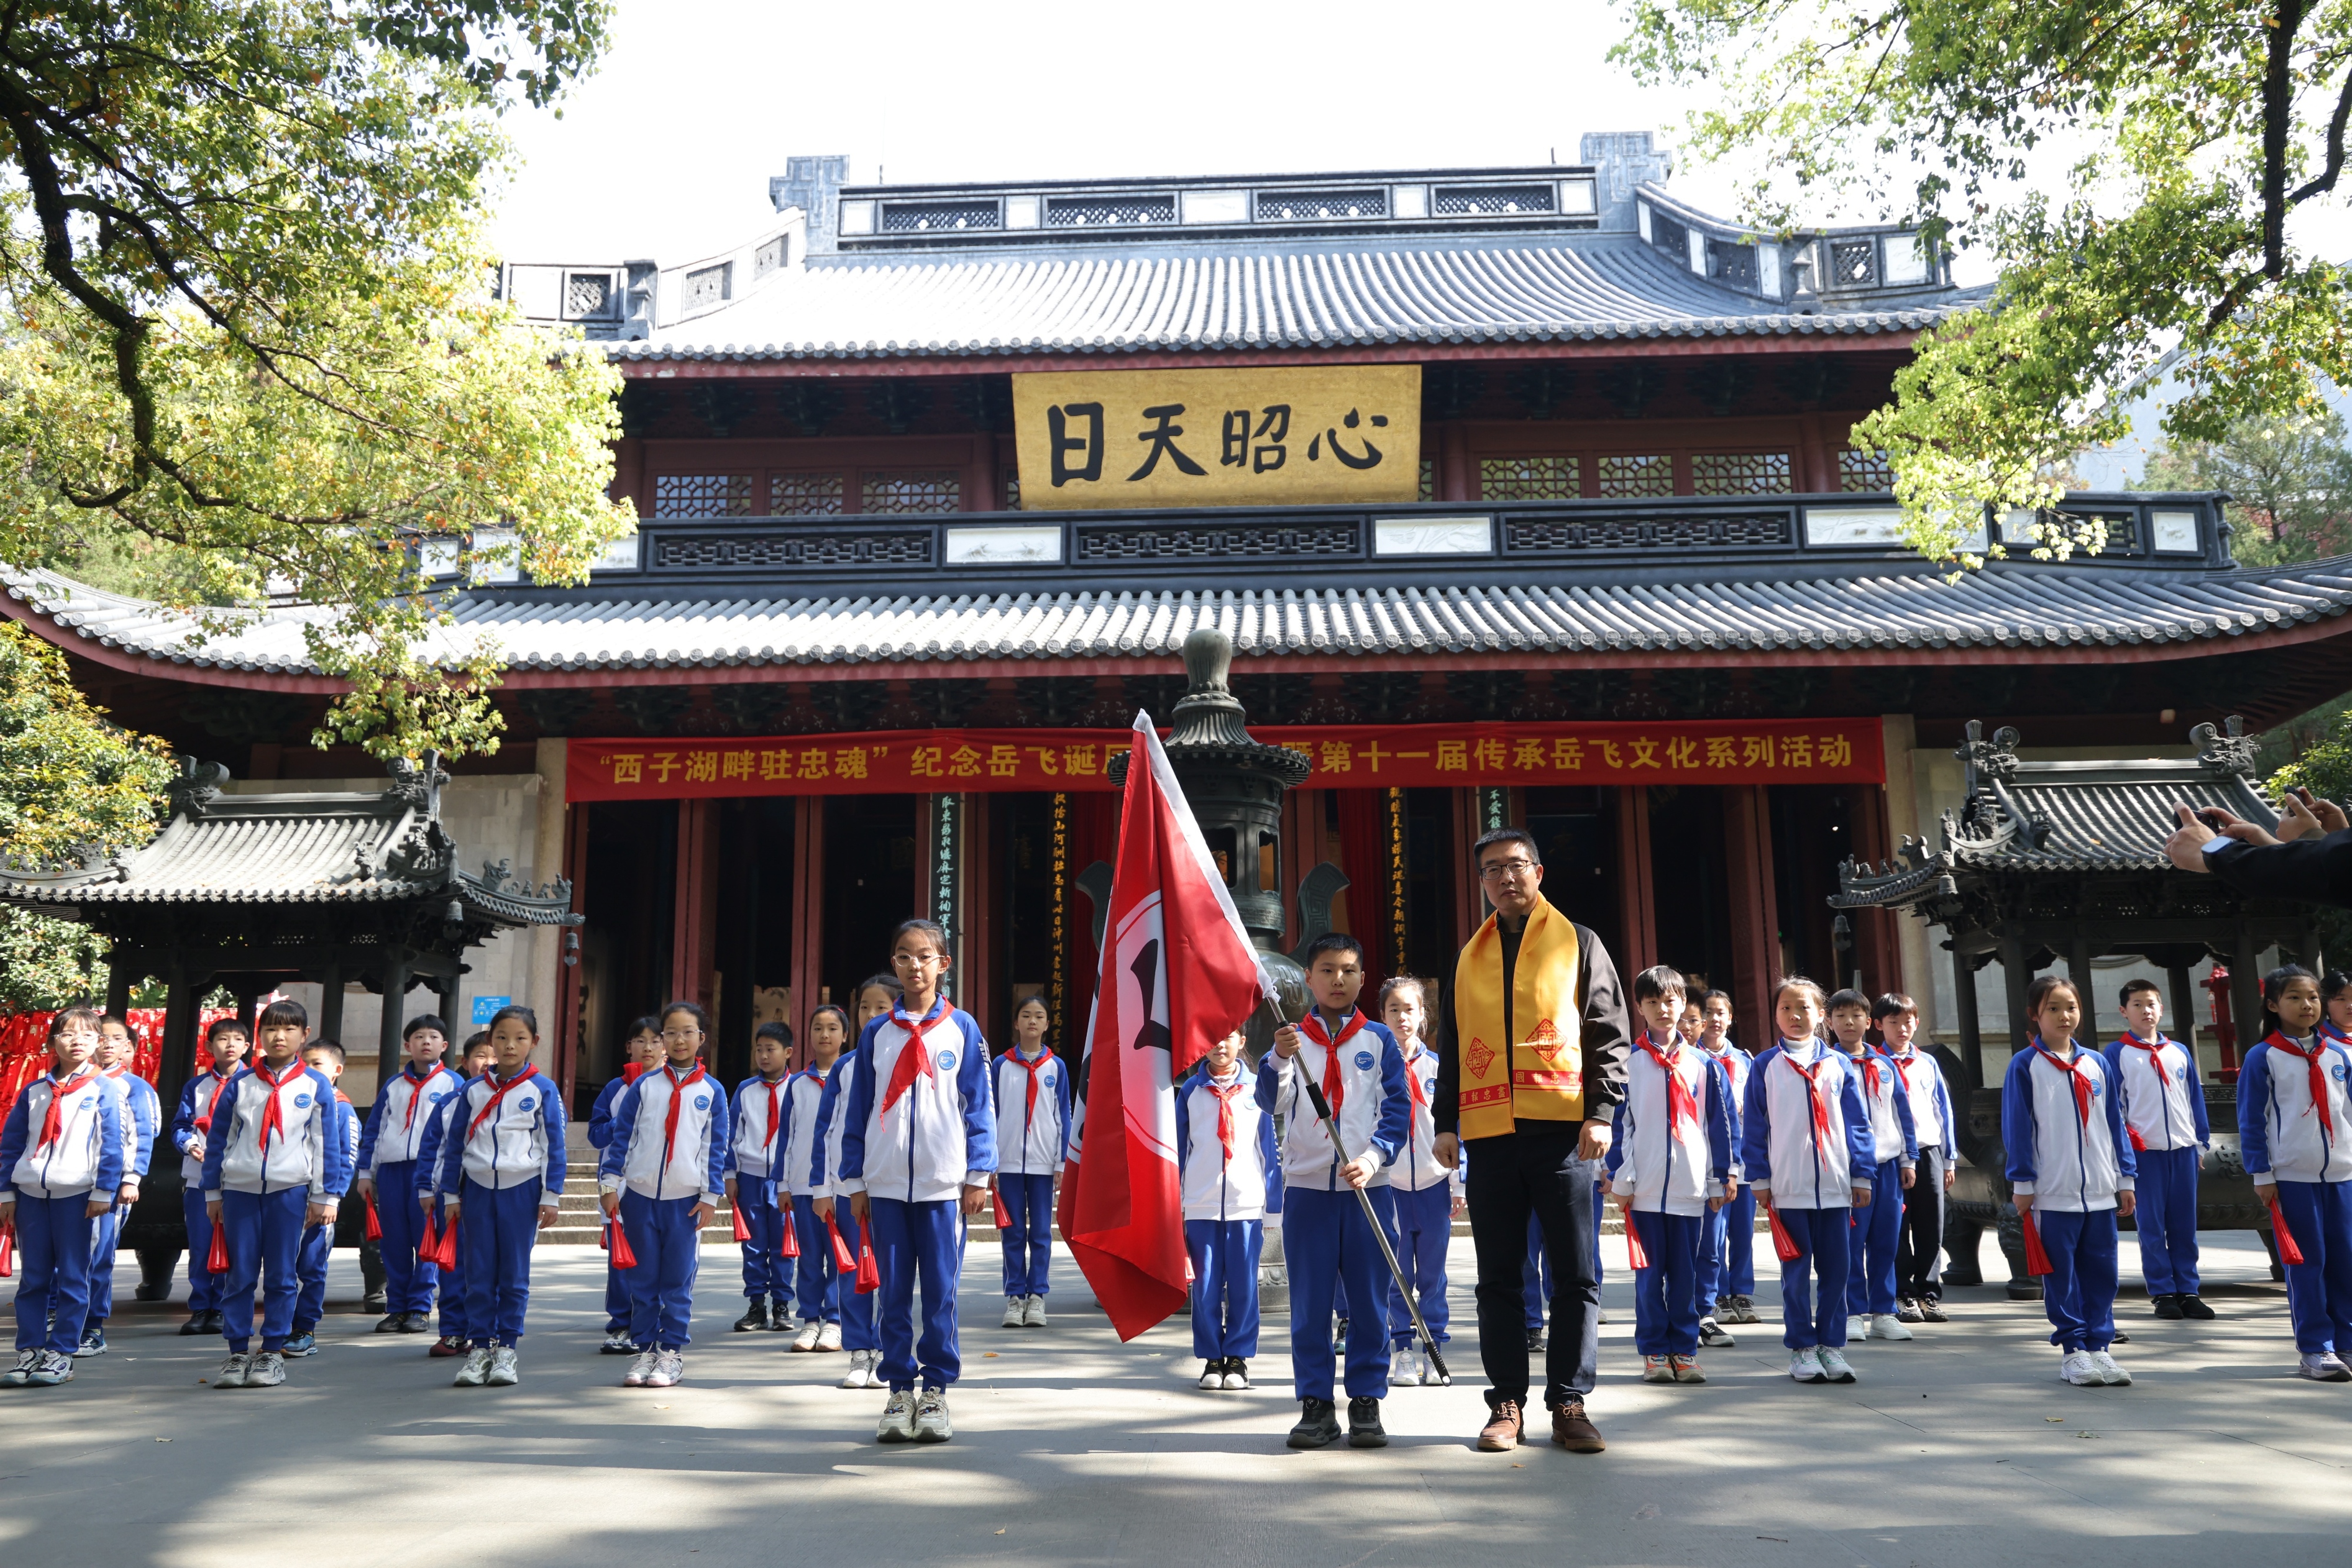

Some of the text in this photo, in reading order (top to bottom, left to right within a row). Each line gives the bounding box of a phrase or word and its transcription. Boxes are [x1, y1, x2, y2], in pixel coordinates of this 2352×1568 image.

[600, 746, 887, 784] “西子湖畔驻忠魂”
